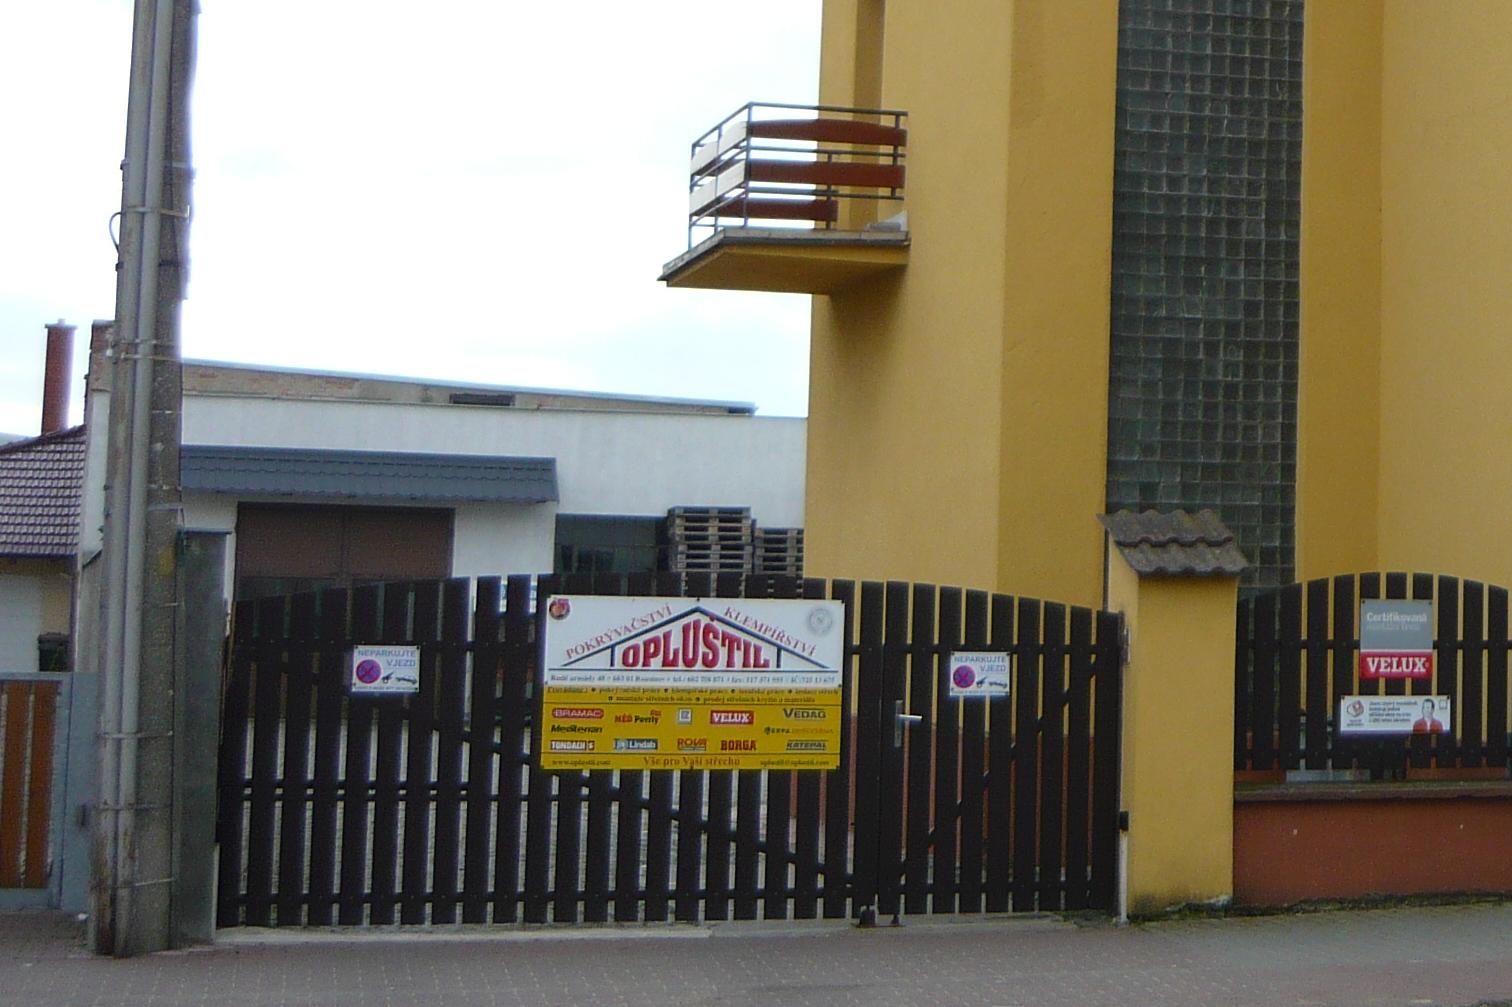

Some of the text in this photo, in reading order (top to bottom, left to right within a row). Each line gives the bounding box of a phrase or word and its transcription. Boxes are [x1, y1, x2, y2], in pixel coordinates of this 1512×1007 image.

[621, 612, 770, 668] OPLUŠTIL
[358, 649, 416, 657] NEPARKUJTE
[1366, 656, 1427, 673] VELUX
[554, 708, 601, 718] BRAMAC
[712, 712, 750, 723] VELUX
[720, 739, 757, 751] BORGA
[643, 756, 660, 765] Vše
[663, 758, 681, 767] pro
